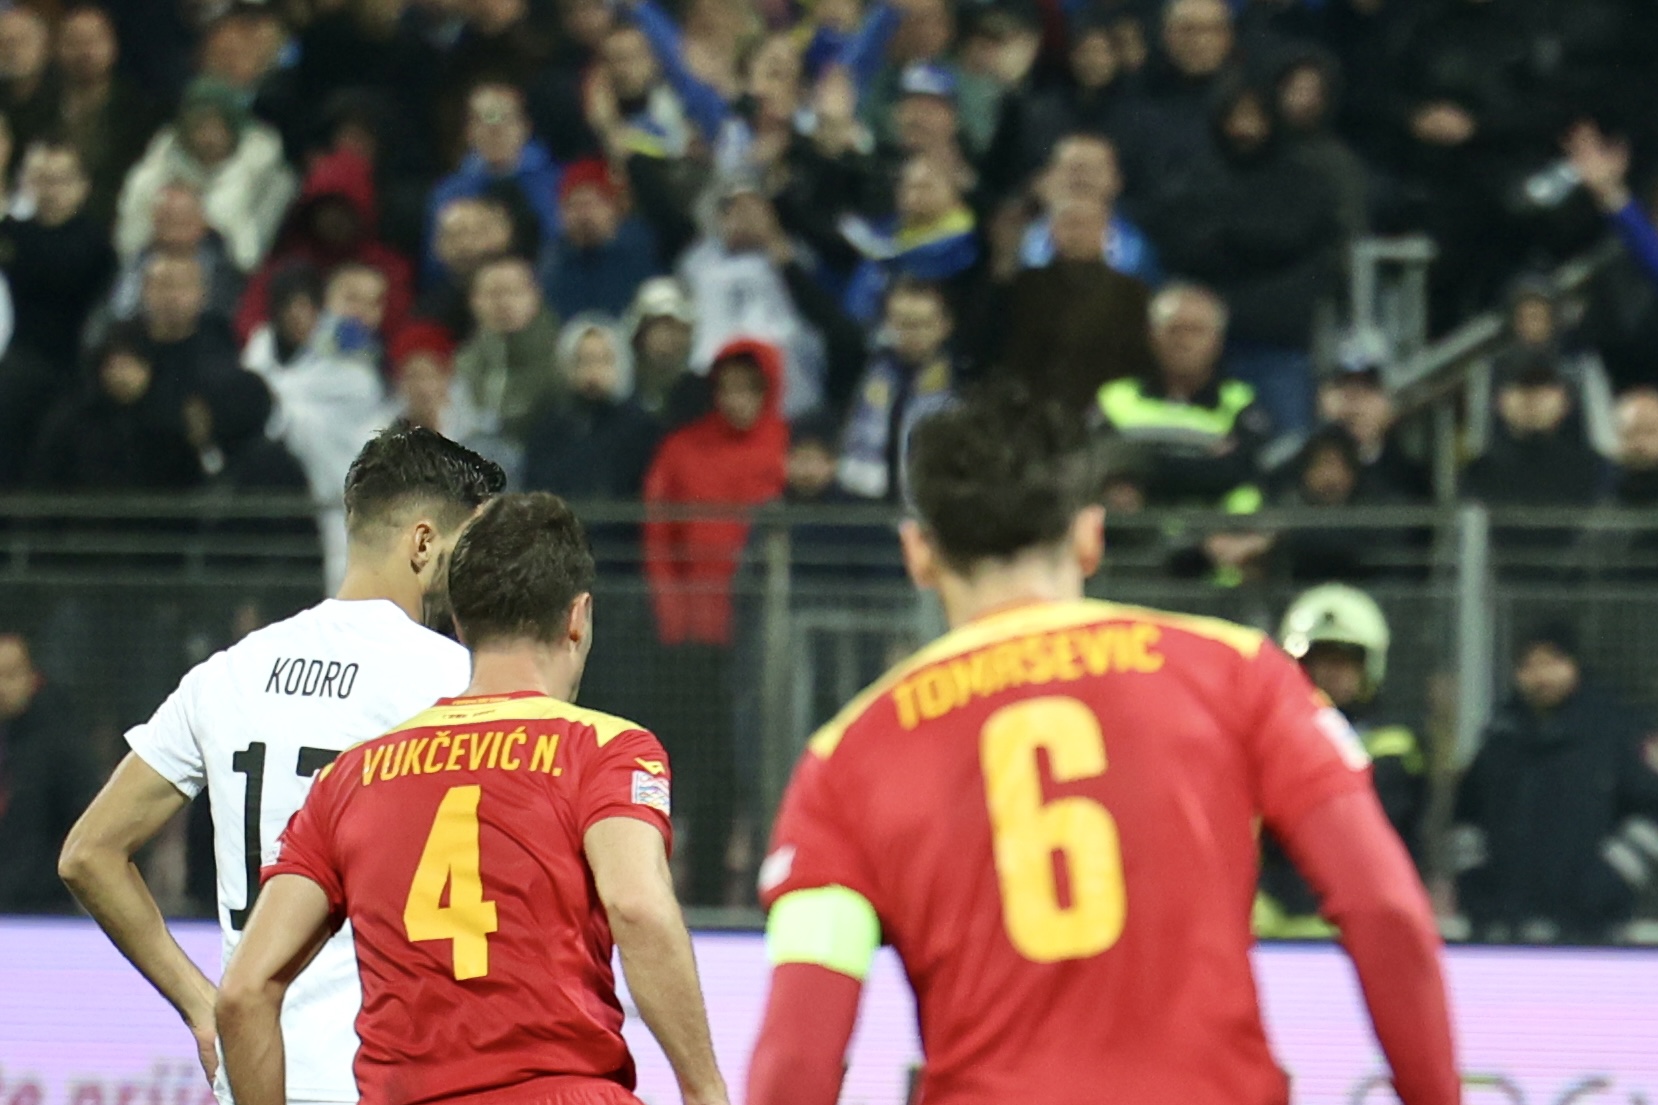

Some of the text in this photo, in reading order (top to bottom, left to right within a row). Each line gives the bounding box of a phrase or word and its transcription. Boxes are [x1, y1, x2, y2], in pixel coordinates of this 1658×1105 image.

[265, 656, 360, 700] KODRO
[361, 725, 564, 787] VUKČEVIĆ N.
[403, 784, 499, 982] 4
[980, 695, 1128, 964] 6
